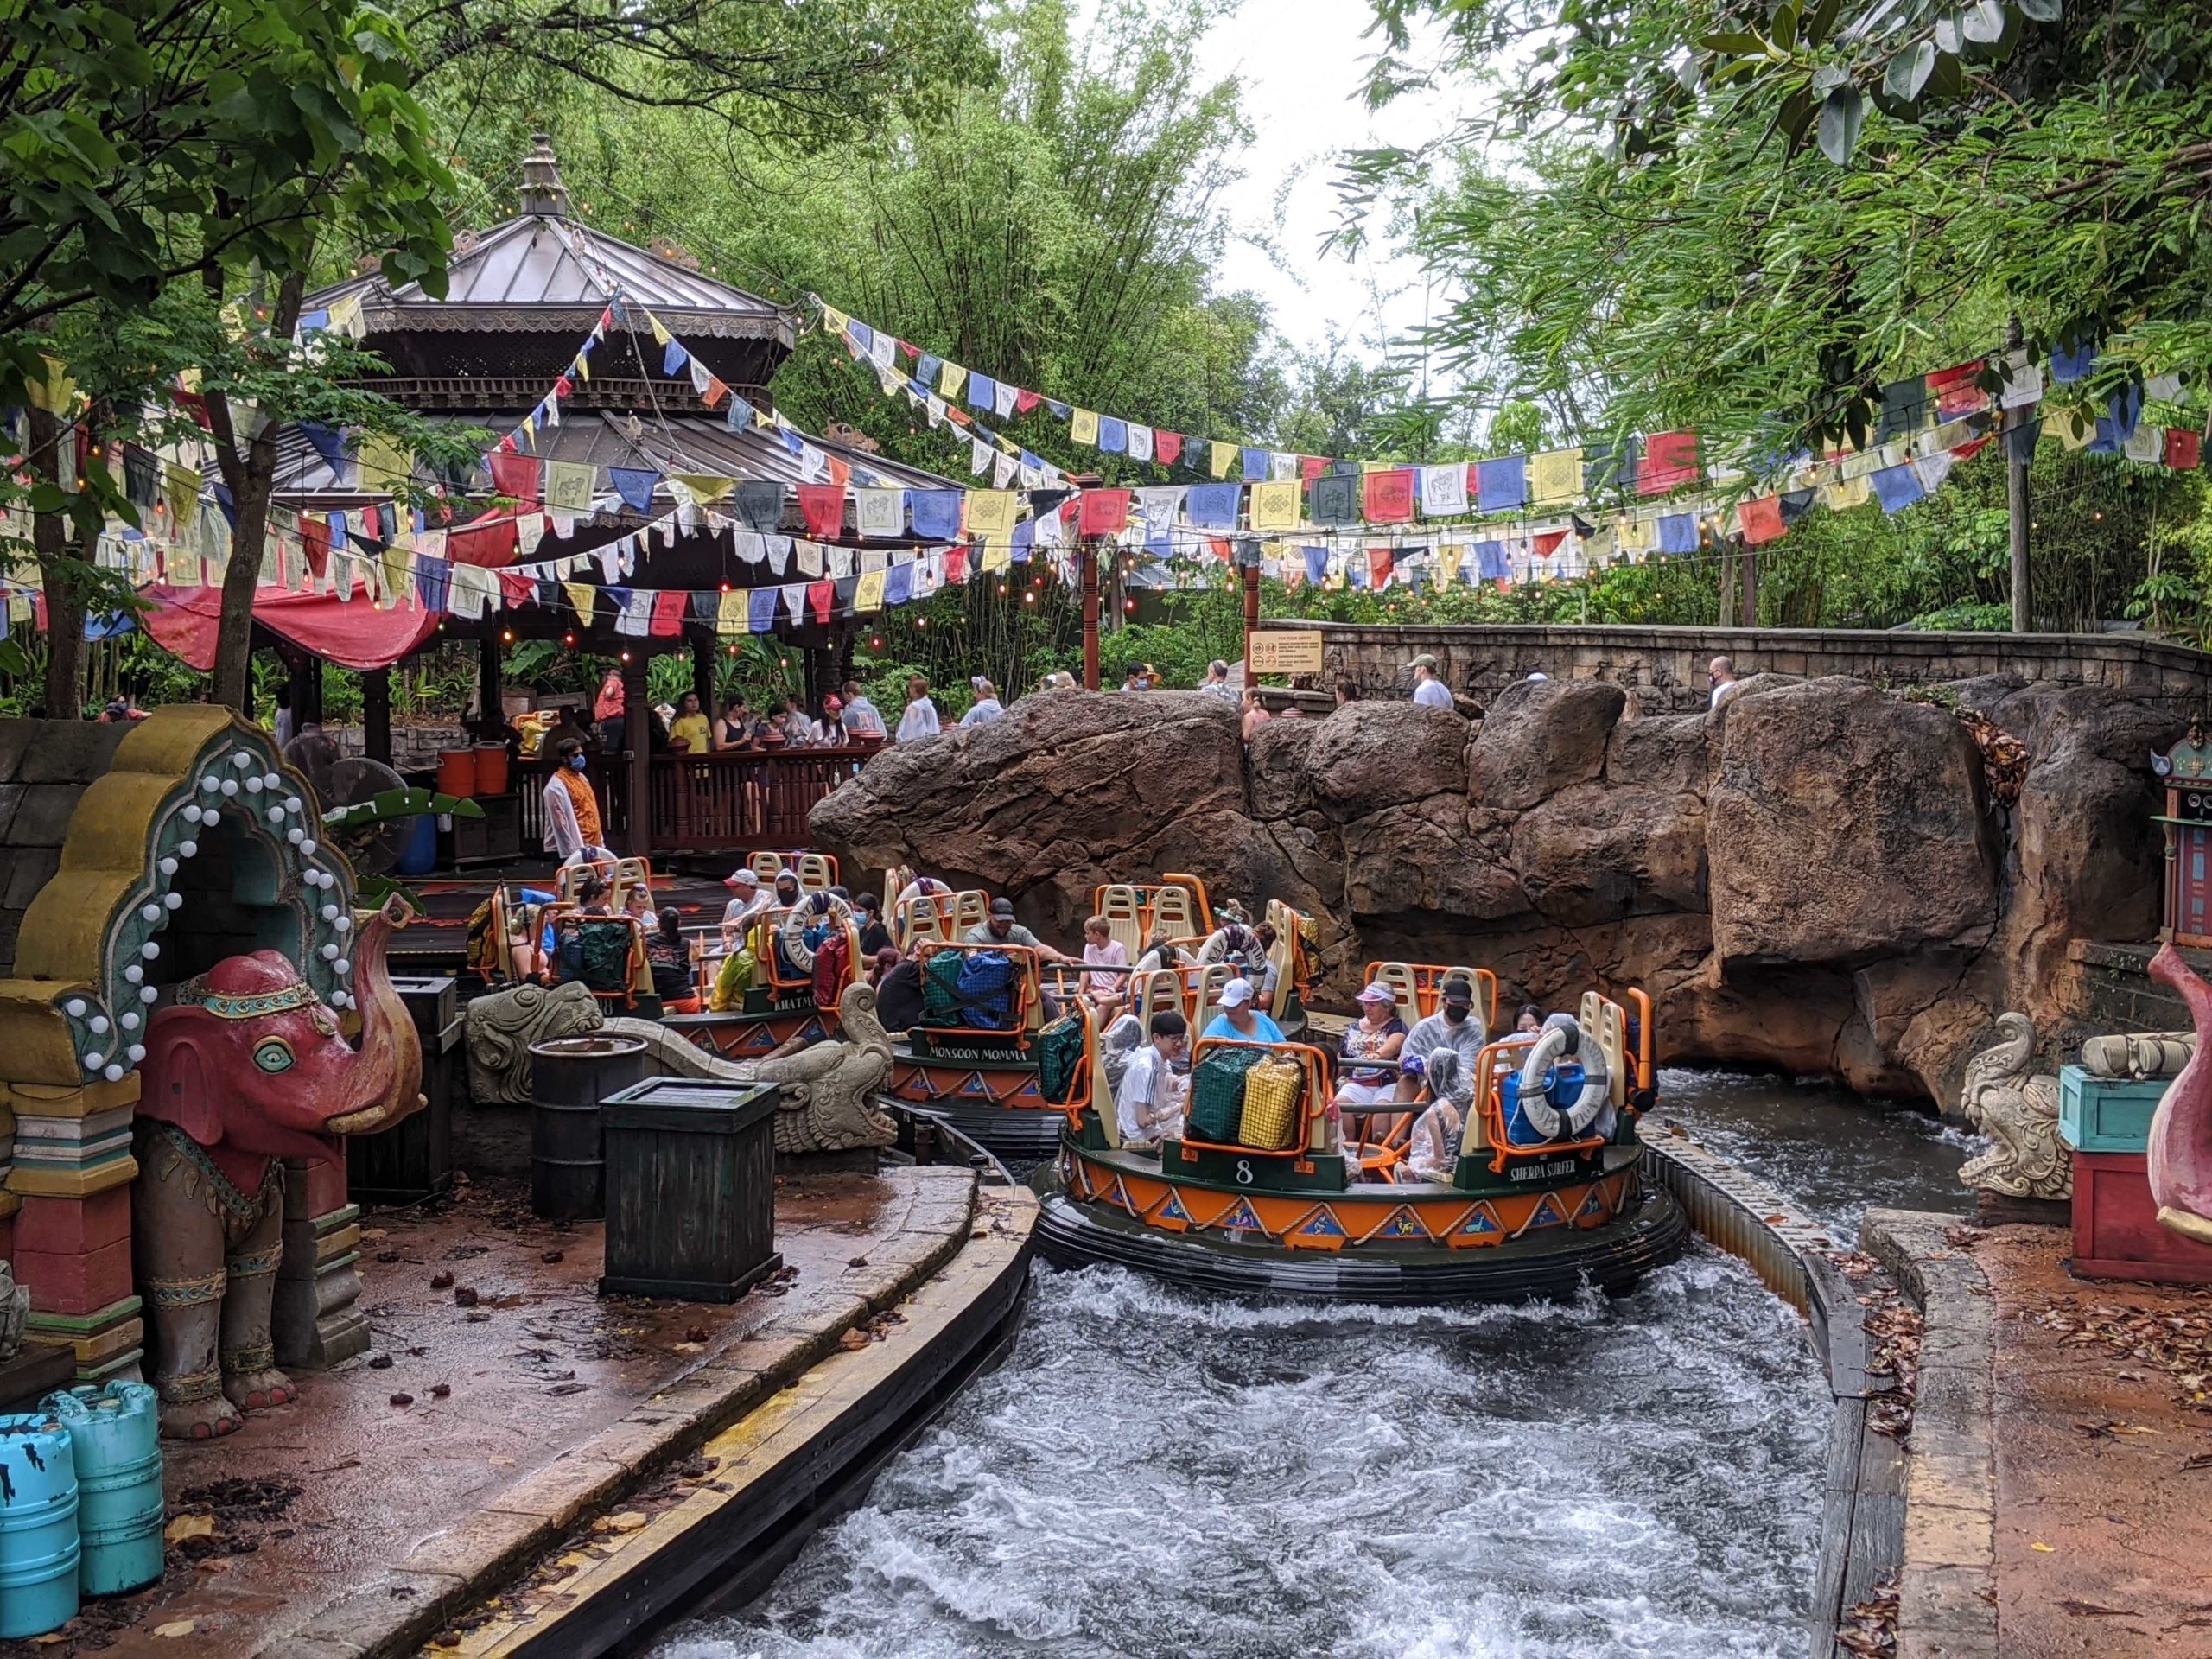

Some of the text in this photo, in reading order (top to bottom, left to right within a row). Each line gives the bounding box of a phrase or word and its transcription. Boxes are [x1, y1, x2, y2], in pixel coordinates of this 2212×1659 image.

[791, 941, 813, 968] EXPE
[929, 1046, 1027, 1061] MONSOON MOMMA
[1236, 1160, 1253, 1184] 8
[1510, 1159, 1576, 1182] SHERPA SURFER
